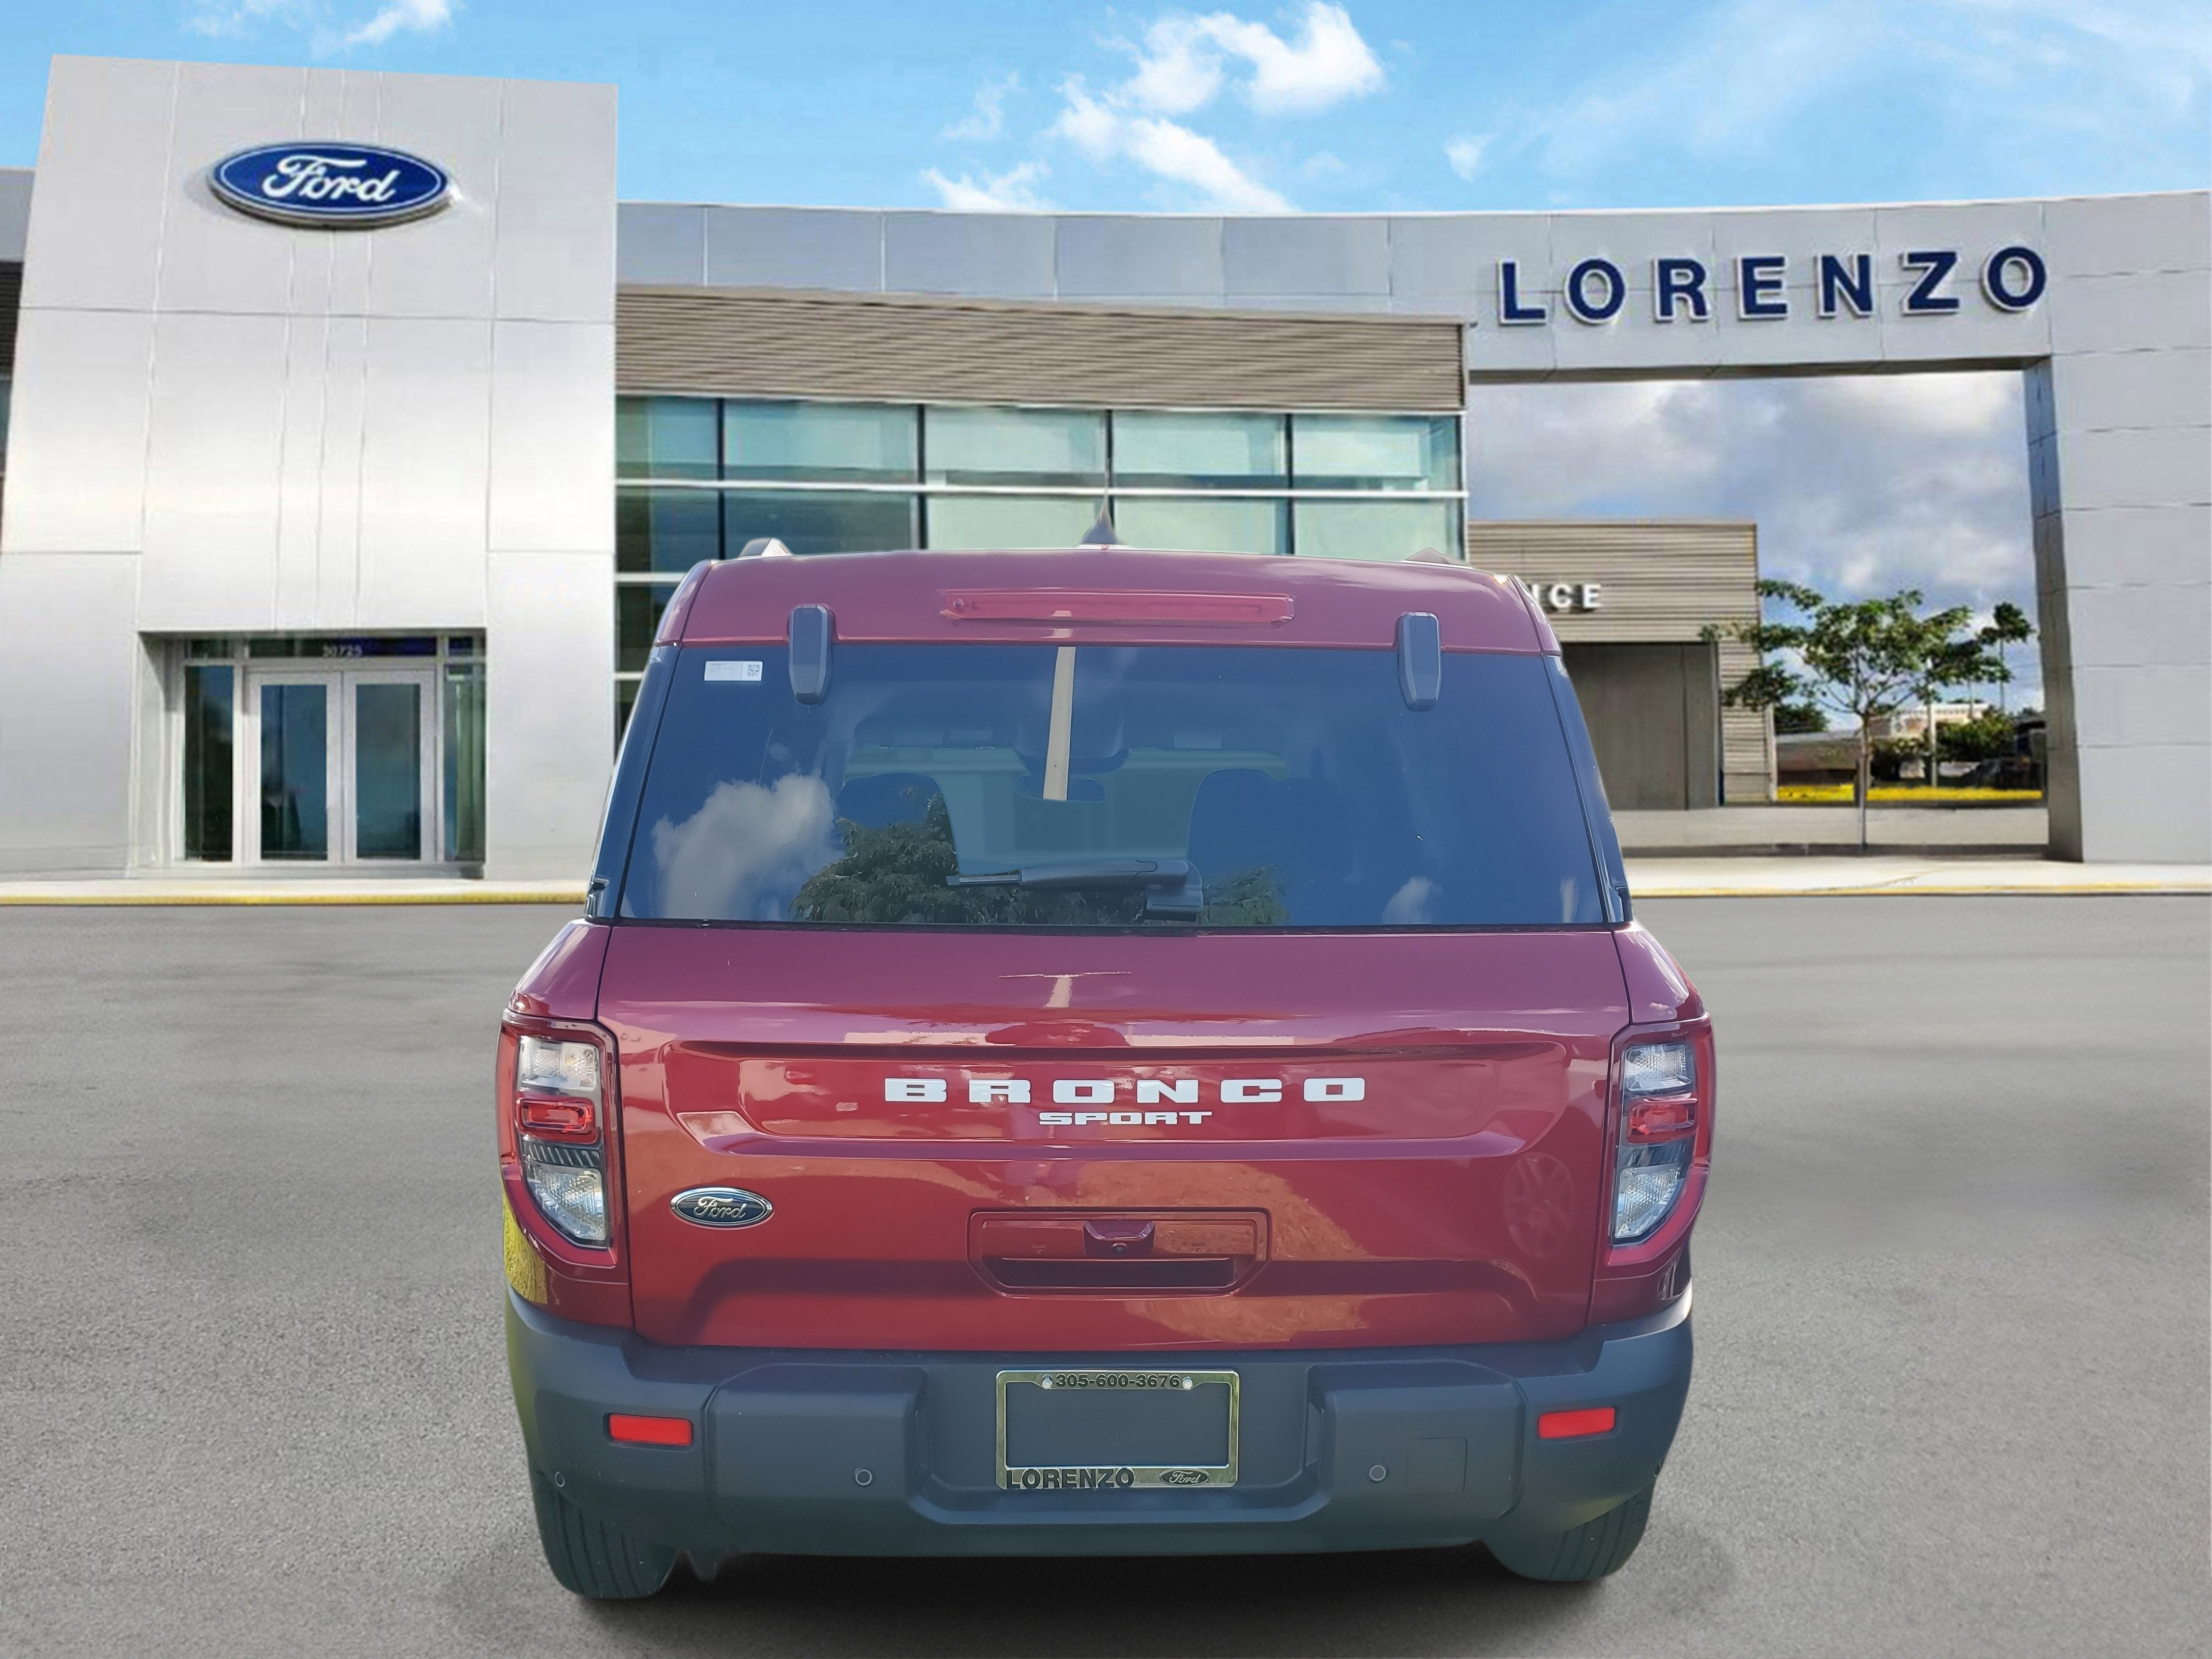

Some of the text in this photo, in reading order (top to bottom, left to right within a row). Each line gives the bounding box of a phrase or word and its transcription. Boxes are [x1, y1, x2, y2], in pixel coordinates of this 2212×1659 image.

[262, 154, 401, 202] Ford
[1497, 246, 2047, 325] LORENZO
[884, 1077, 1365, 1104] BRONCO
[1039, 1111, 1213, 1125] SPORT
[693, 1196, 748, 1219] Ford
[1055, 1374, 1181, 1388] 305-600-3676
[1005, 1467, 1201, 1490] LORENZO Ford
